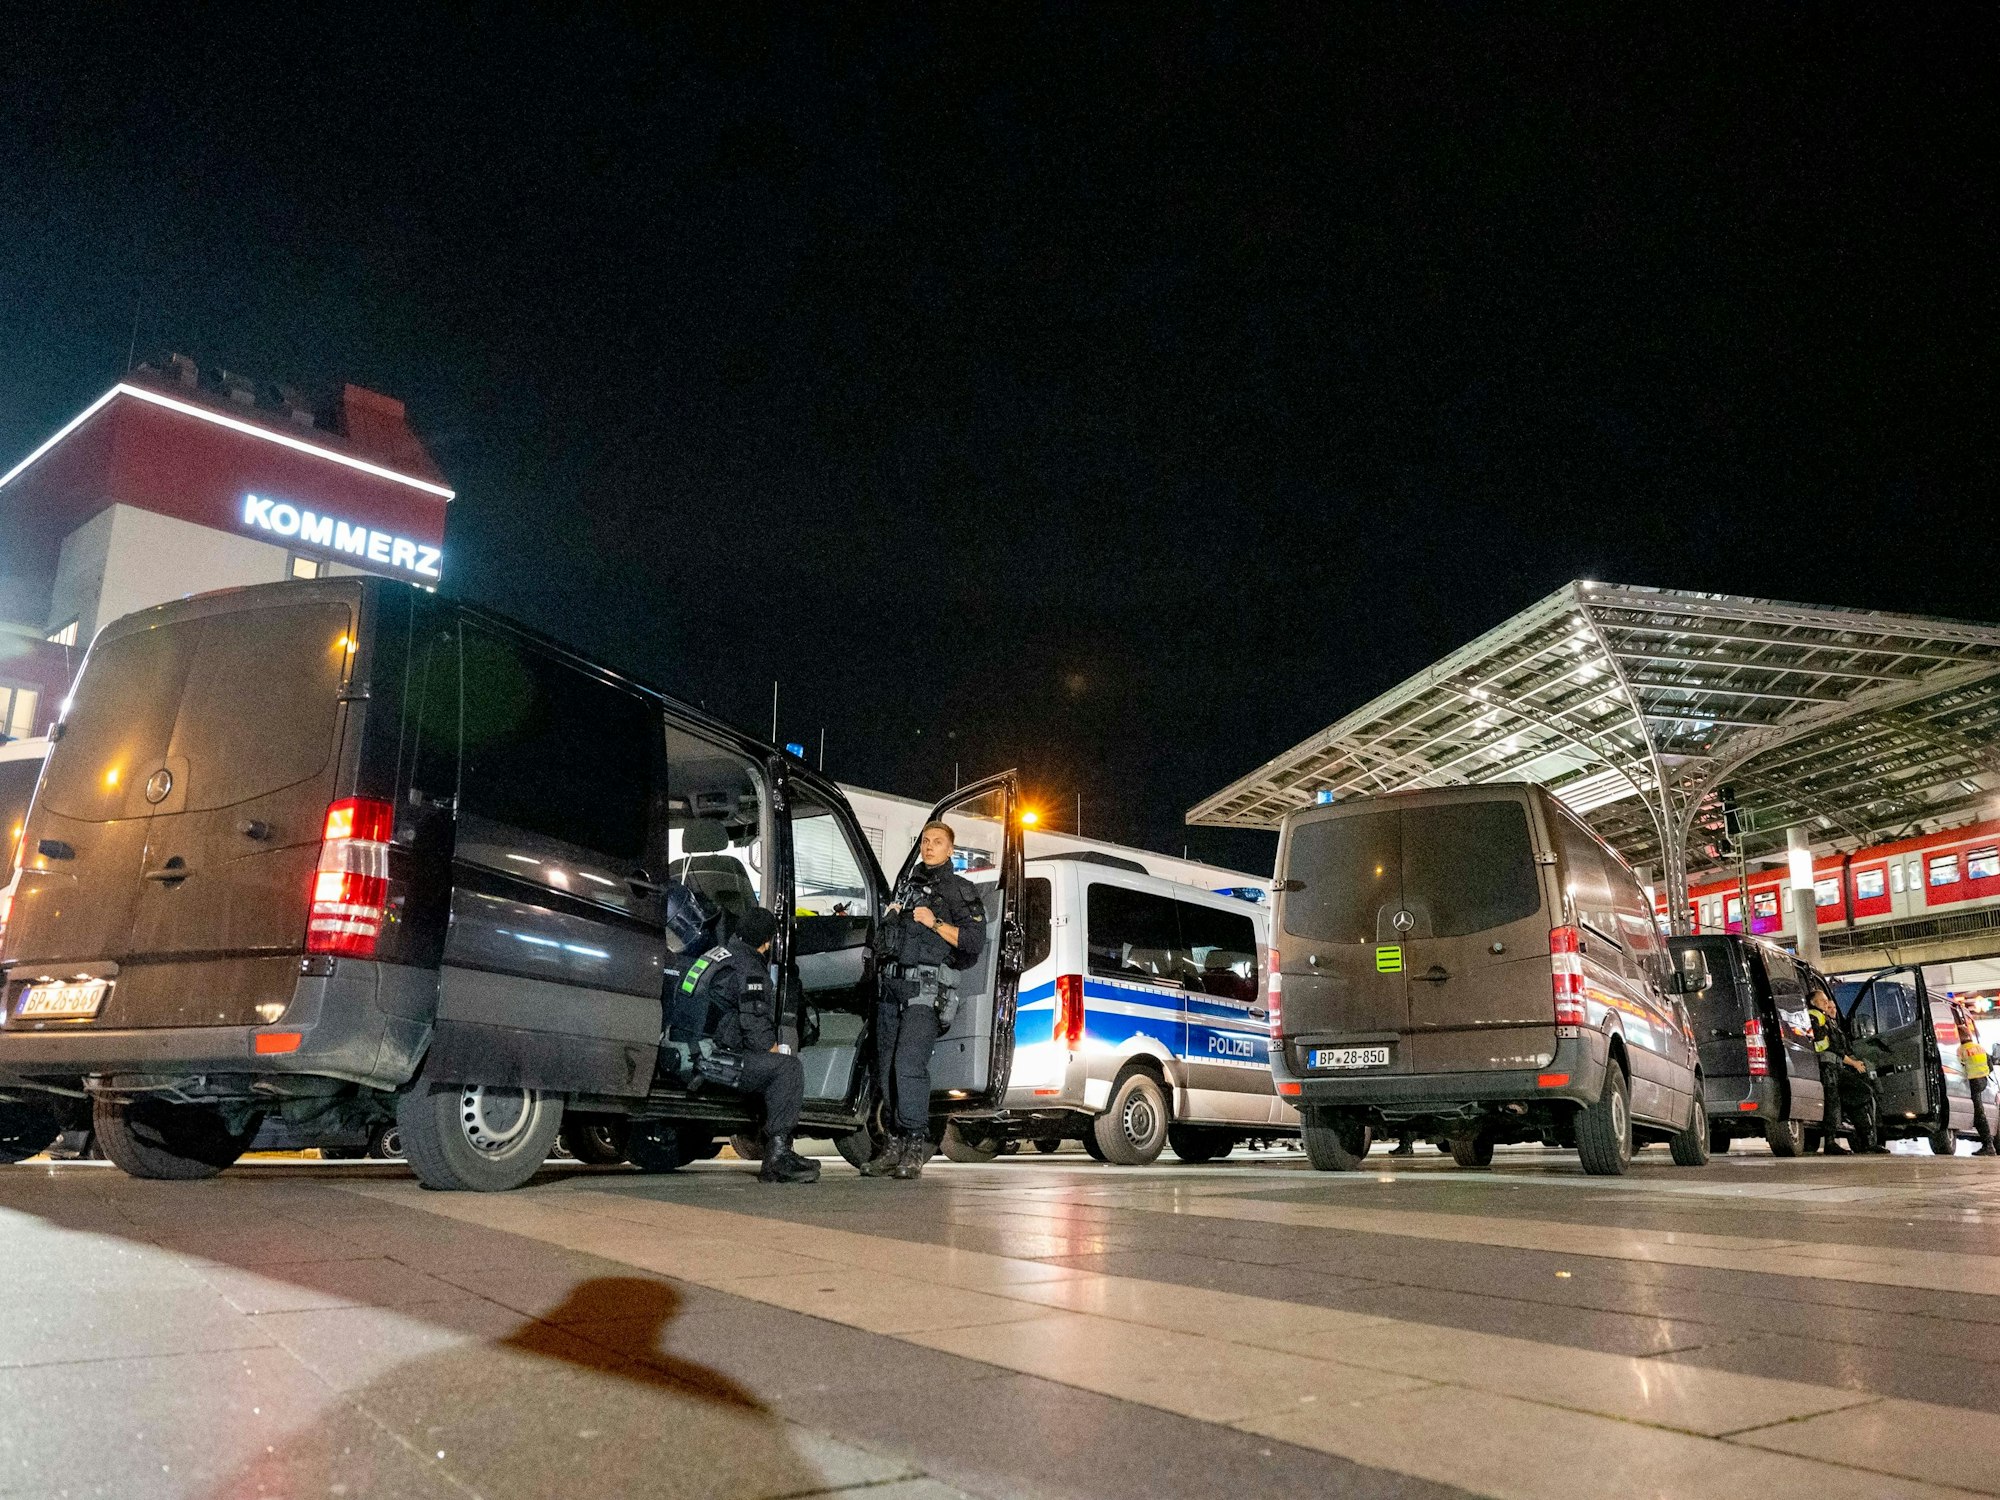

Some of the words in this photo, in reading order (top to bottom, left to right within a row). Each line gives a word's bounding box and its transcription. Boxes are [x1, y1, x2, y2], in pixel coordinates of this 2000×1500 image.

[244, 494, 441, 577] KOMMERZ
[27, 991, 47, 1011] BP
[1208, 1036, 1254, 1057] POLIZEI
[1320, 1052, 1335, 1065] BP
[1343, 1050, 1385, 1064] 28-850
